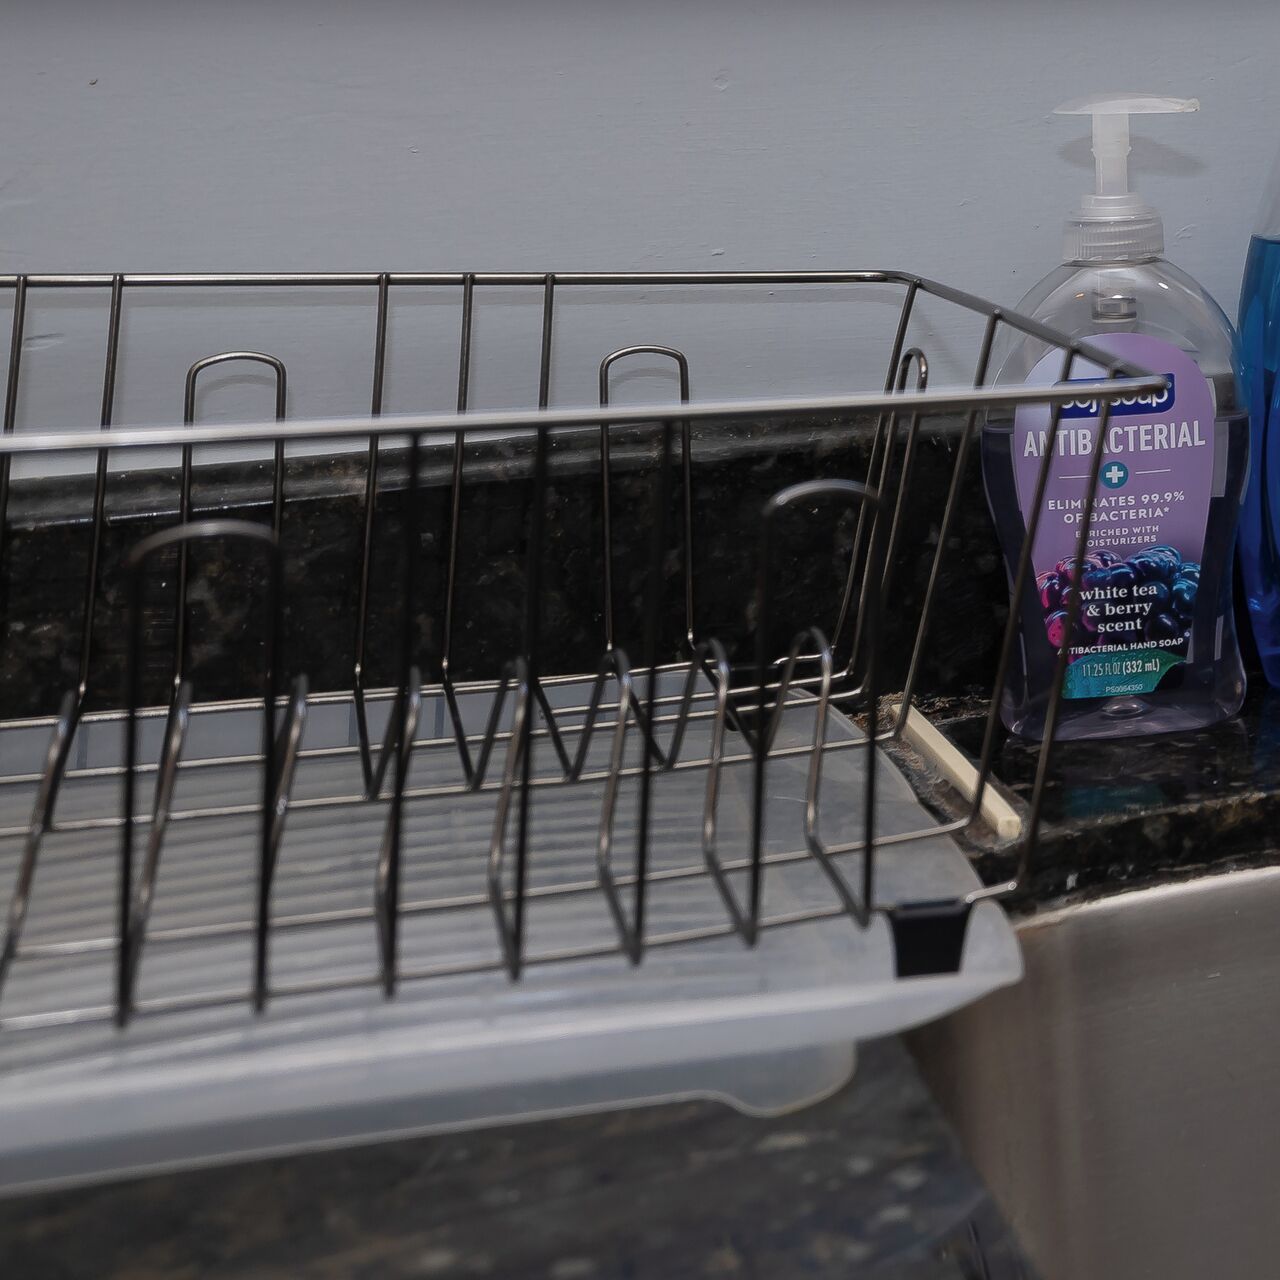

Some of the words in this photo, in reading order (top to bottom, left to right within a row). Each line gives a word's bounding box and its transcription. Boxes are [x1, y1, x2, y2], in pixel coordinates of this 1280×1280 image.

[1141, 490, 1185, 504] 99.9%
[1063, 513, 1084, 524] OF
[1075, 527, 1129, 538] ERICHED
[1132, 525, 1160, 534] WITH
[1087, 535, 1157, 547] OISTURIZERS
[1079, 586, 1128, 600] white
[1132, 585, 1158, 597] tea
[1086, 604, 1100, 617] &
[1105, 602, 1153, 616] berry
[1097, 617, 1143, 633] scent
[1057, 642, 1128, 656] ATIBACTERIAL
[1130, 640, 1157, 651] HAND
[1159, 637, 1184, 647] SOAP
[1082, 664, 1104, 677] 11.25
[1105, 662, 1112, 675] FL
[1112, 662, 1121, 674] OZ
[1122, 660, 1143, 675] (332
[1144, 658, 1160, 673] mL)
